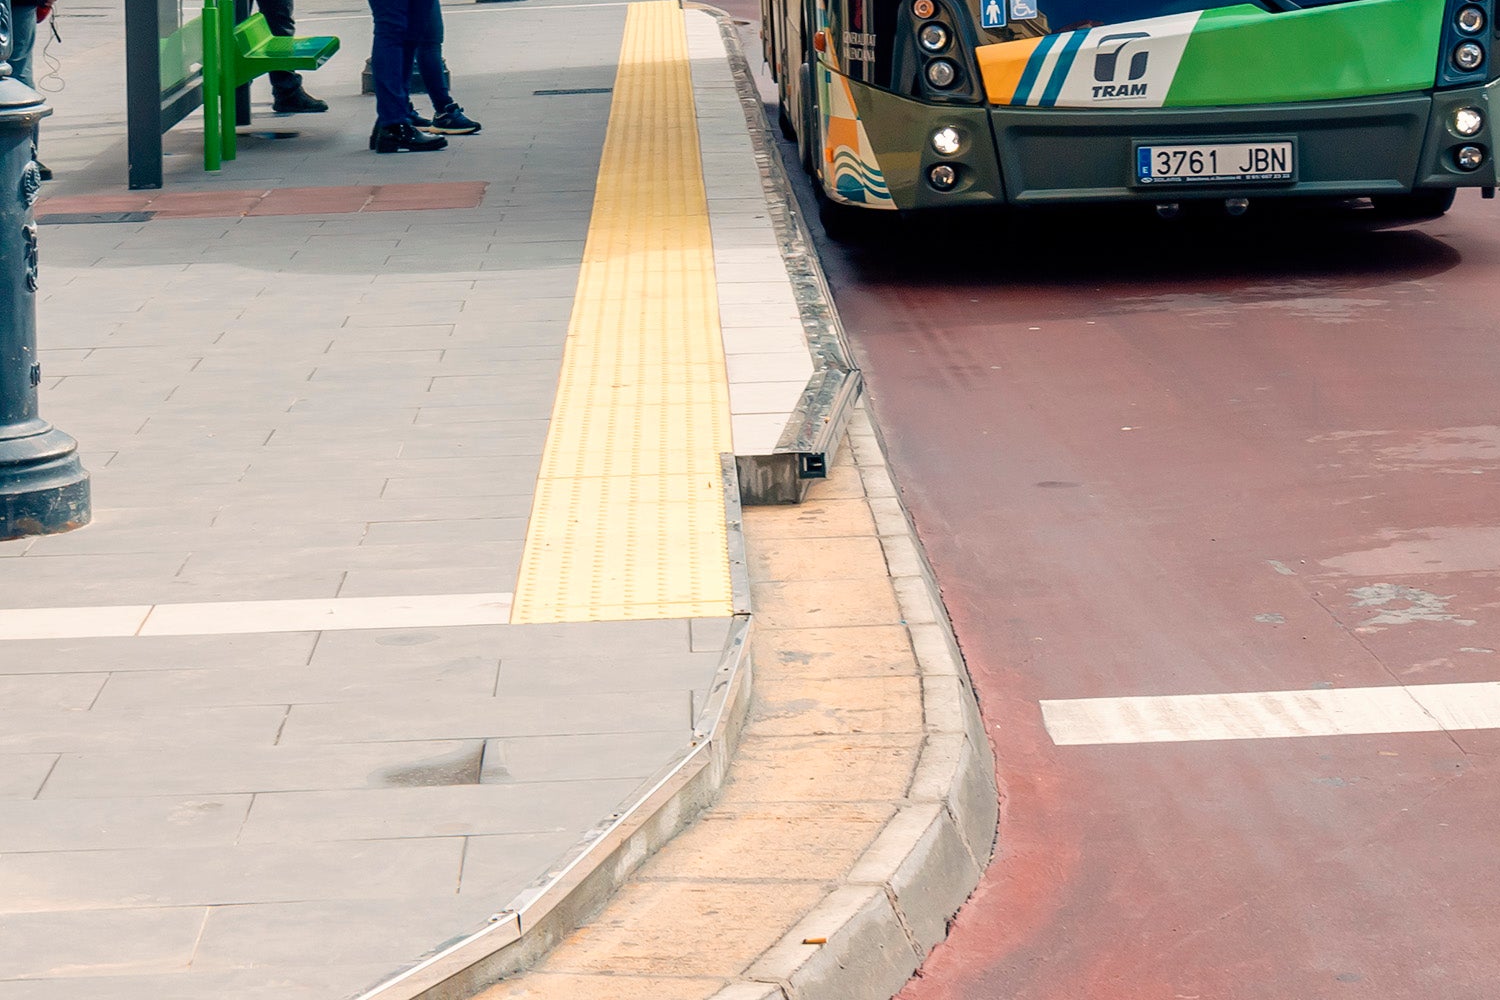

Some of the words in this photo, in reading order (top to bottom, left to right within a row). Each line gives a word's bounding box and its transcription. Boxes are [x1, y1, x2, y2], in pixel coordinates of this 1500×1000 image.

[1092, 83, 1148, 98] TRAM
[1156, 150, 1217, 176] 3761
[1238, 147, 1287, 173] JBN
